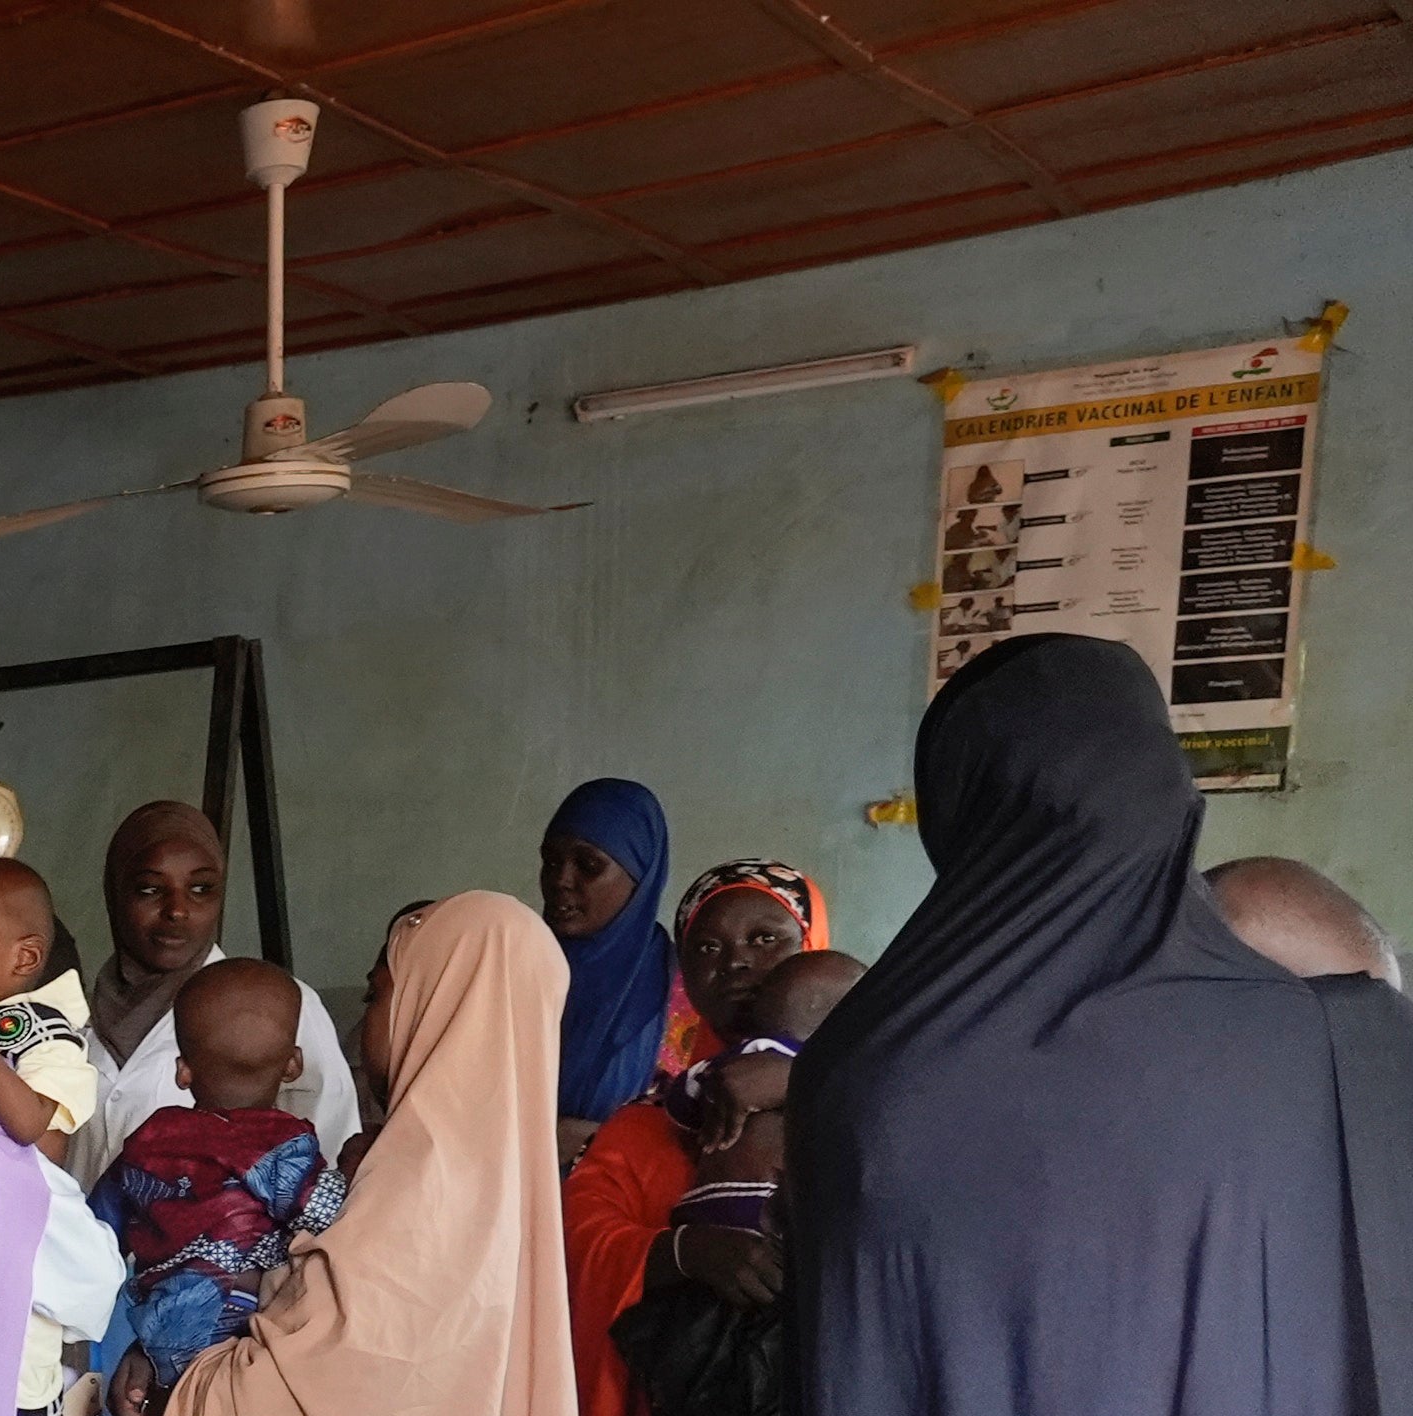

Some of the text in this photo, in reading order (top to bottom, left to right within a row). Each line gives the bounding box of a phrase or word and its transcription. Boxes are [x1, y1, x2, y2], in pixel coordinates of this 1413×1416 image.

[955, 411, 1068, 439] CALENDRIER
[1076, 399, 1167, 423] VACCINAL
[1175, 394, 1200, 411] DE
